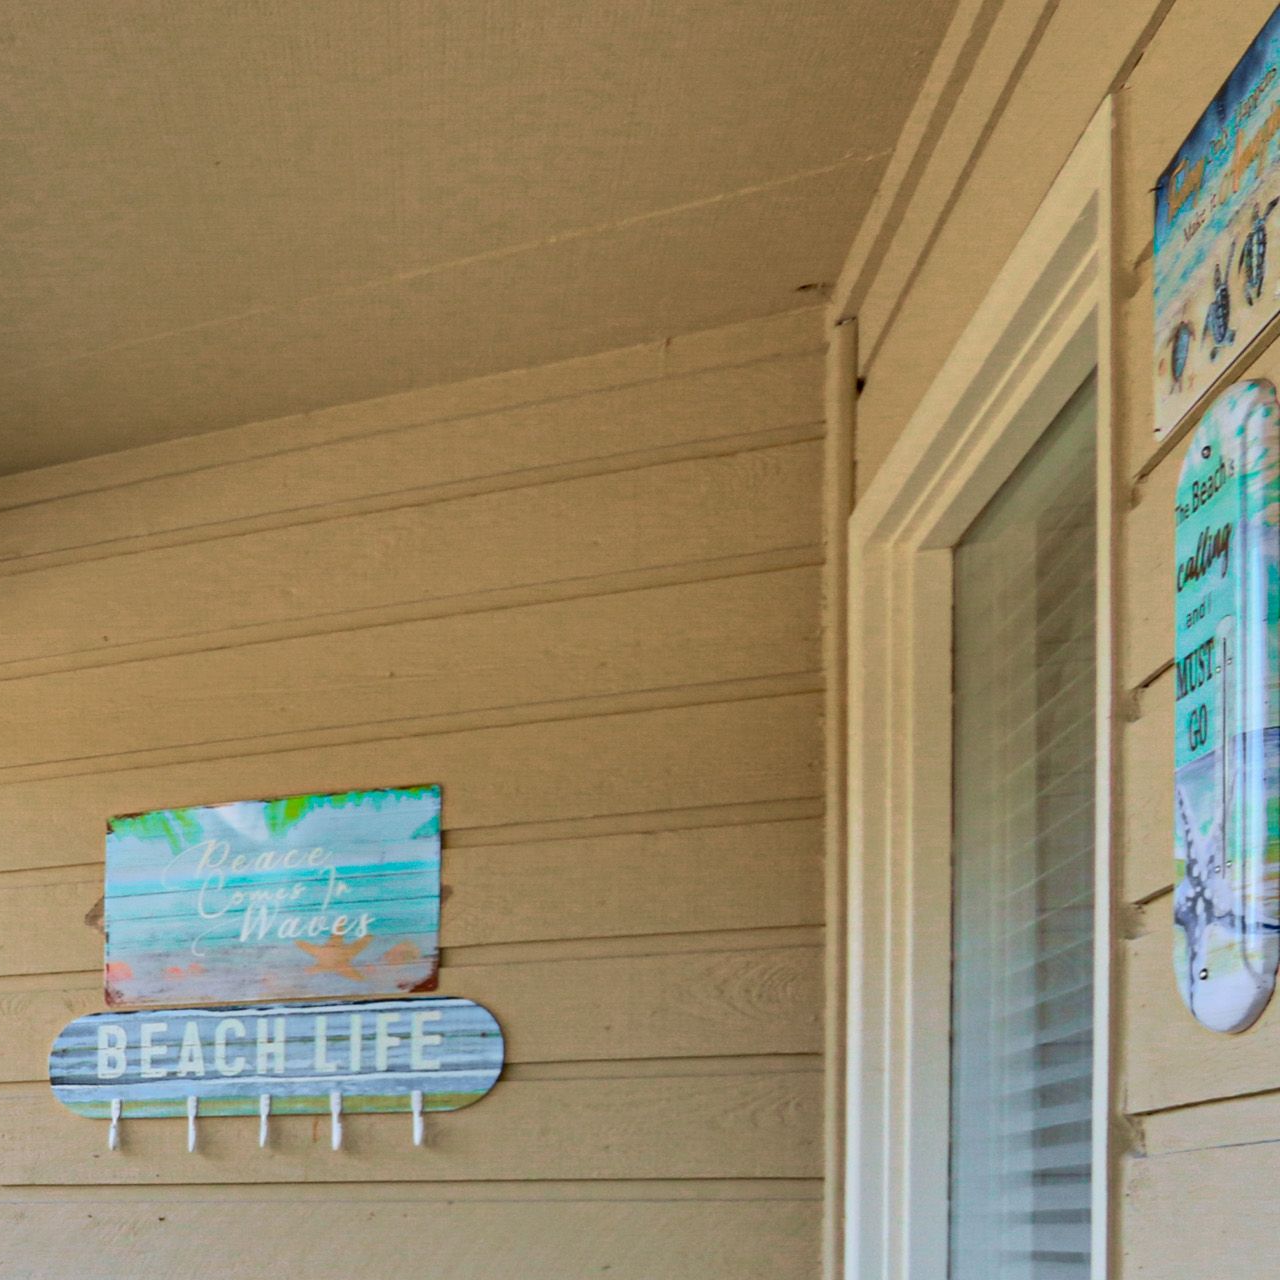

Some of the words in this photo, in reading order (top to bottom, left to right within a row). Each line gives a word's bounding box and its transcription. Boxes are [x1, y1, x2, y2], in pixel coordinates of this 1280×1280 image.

[1192, 456, 1226, 513] Beach
[1177, 522, 1232, 592] calling
[1186, 595, 1206, 629] and
[1175, 636, 1216, 702] MUST
[1189, 703, 1208, 752] GO
[161, 839, 333, 889] Peace
[198, 868, 307, 919] Comes
[319, 864, 352, 913] In
[192, 901, 376, 957] Waves
[96, 1017, 287, 1080] BEACH
[314, 1010, 443, 1073] LIFE
